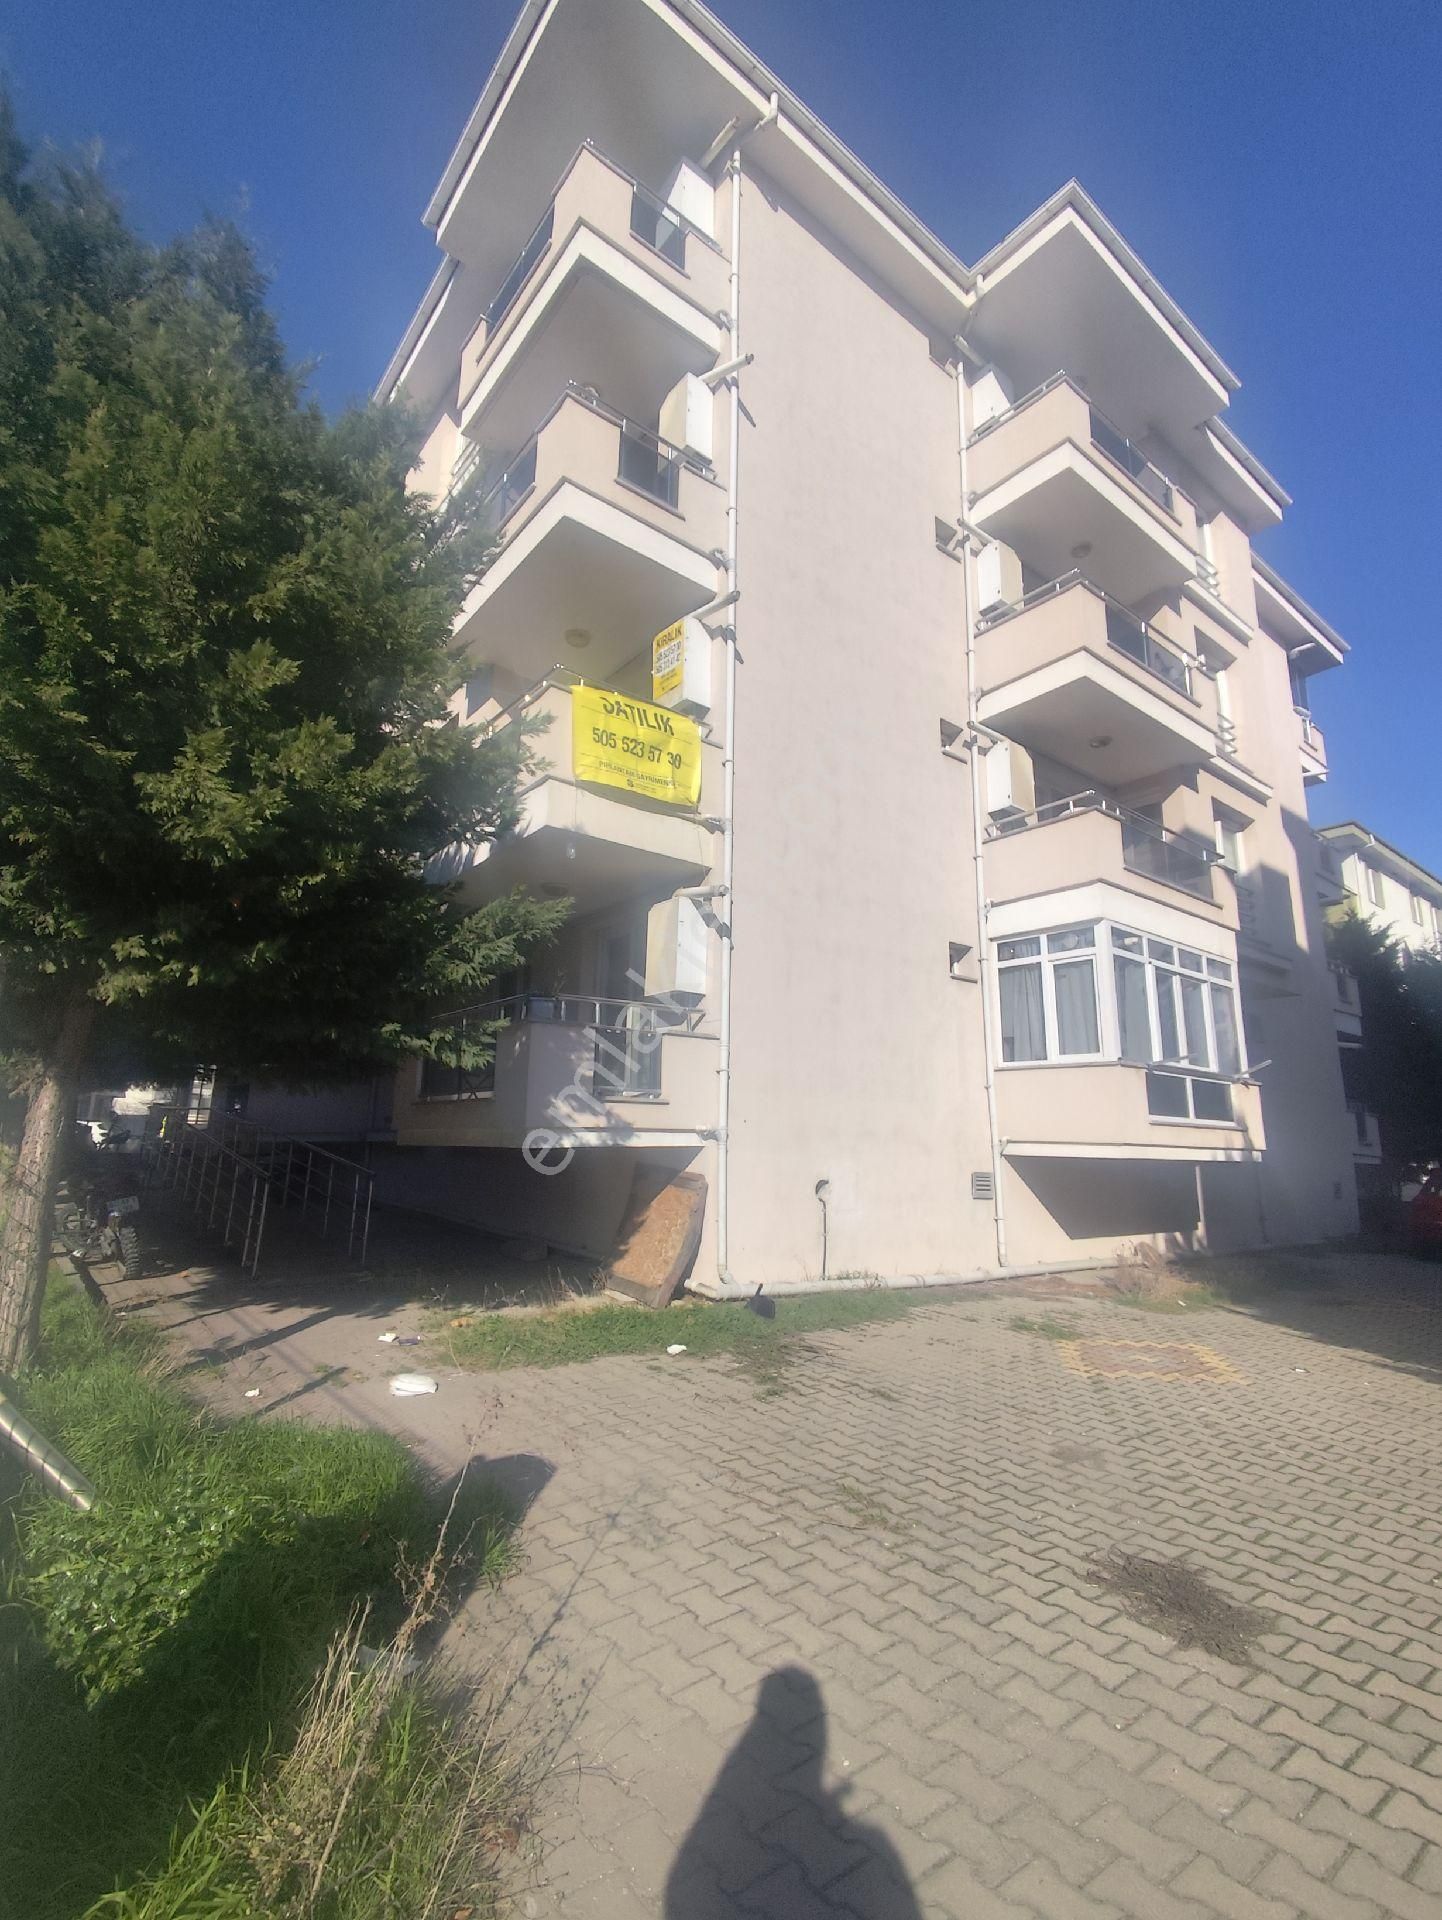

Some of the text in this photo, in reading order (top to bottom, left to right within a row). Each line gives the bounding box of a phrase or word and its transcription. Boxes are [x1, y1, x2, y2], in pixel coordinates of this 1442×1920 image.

[600, 697, 674, 736] SATILIK
[592, 727, 682, 769] 505 523 57 30
